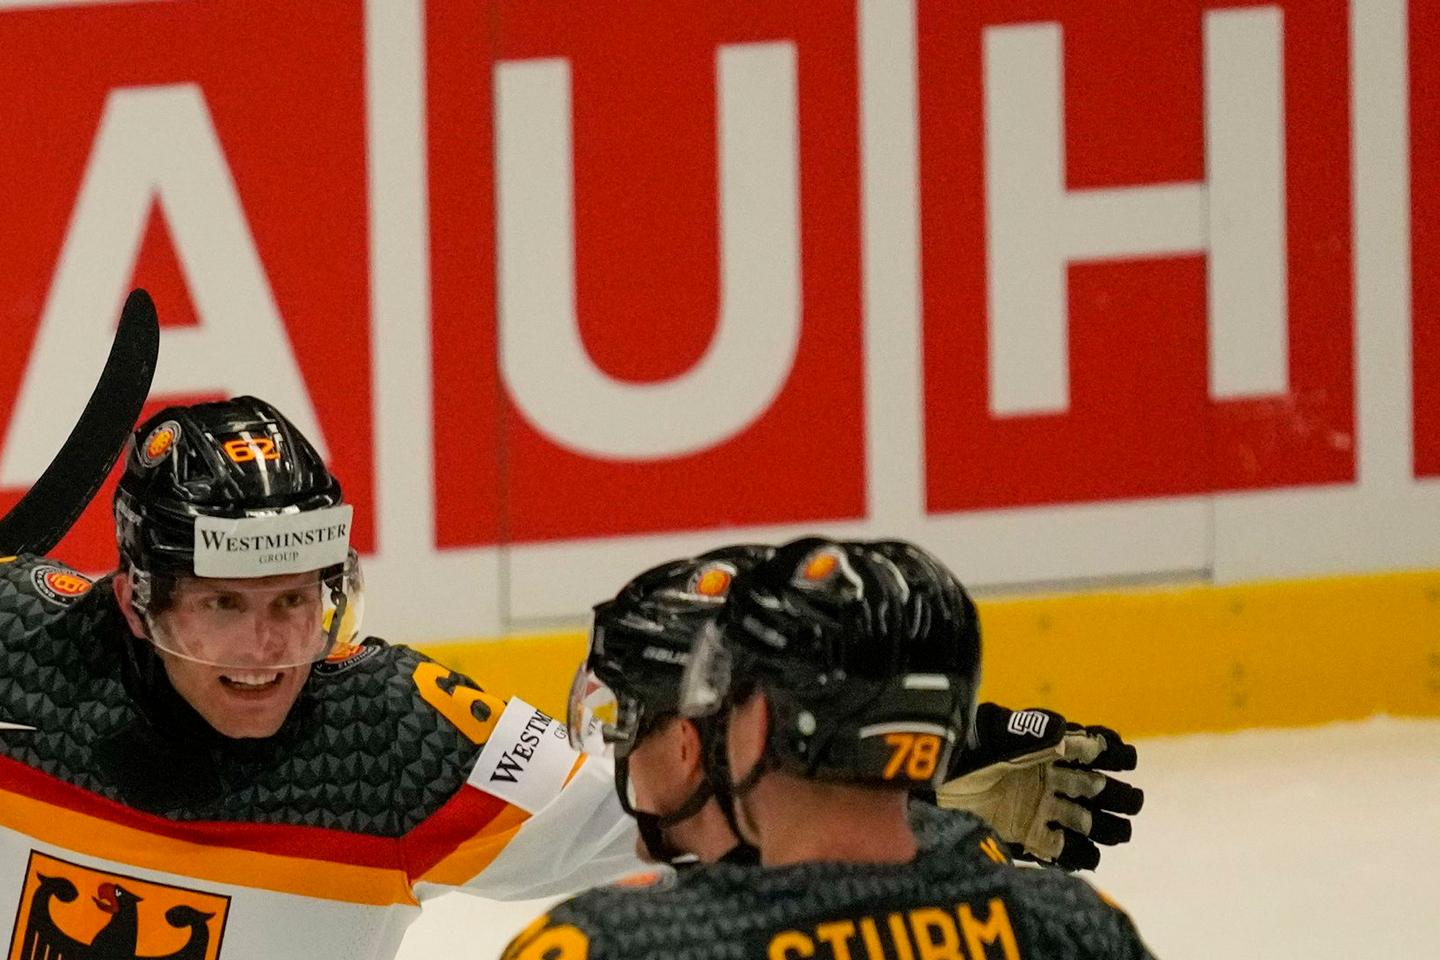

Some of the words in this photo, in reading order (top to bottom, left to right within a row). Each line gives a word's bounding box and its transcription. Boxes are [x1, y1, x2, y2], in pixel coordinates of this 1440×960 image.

[224, 438, 281, 463] 62
[200, 523, 347, 553] WESTMINSTER
[258, 551, 300, 565] GROUP
[883, 733, 941, 781] 78
